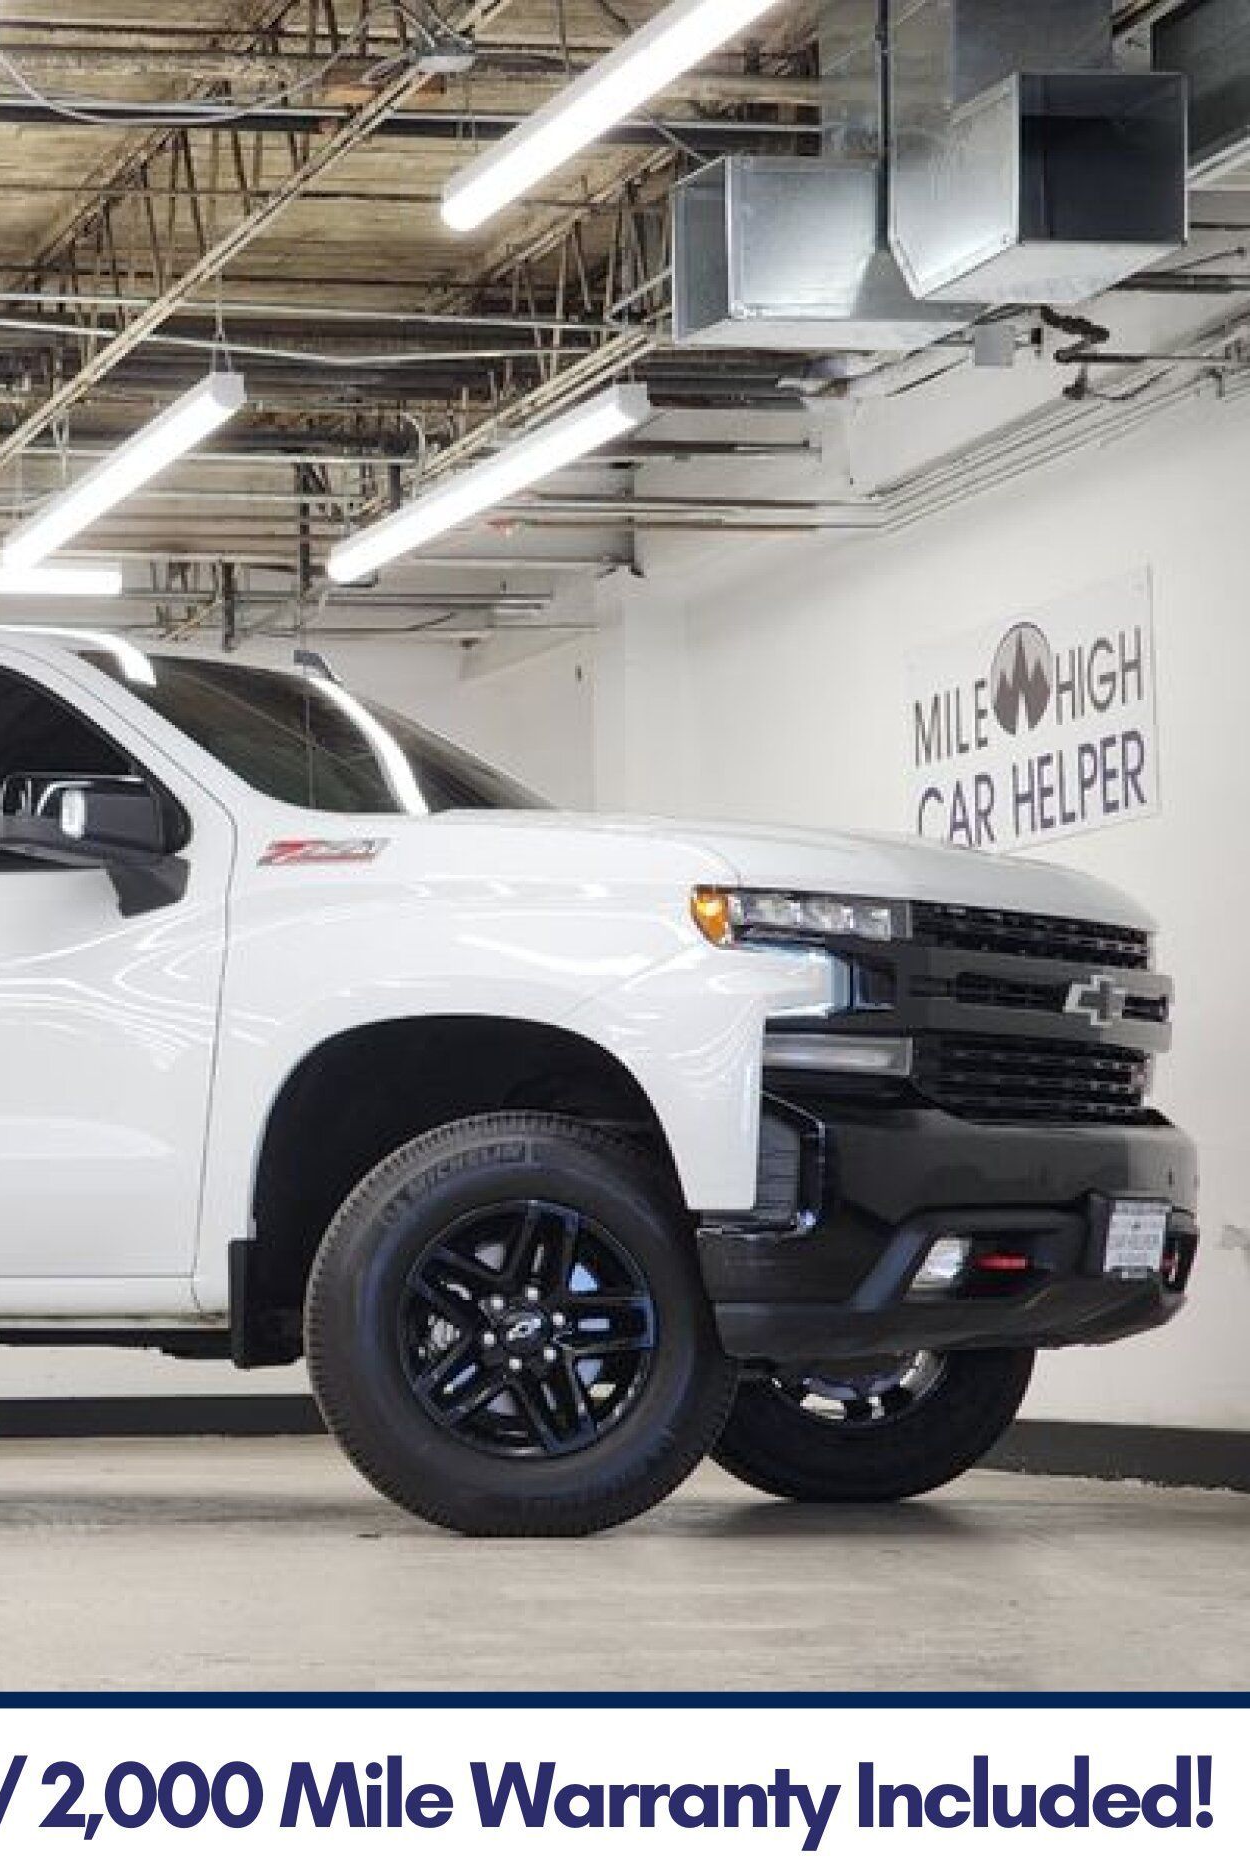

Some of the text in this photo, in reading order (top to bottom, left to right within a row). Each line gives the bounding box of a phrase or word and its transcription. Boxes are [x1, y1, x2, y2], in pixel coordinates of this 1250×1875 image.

[914, 624, 1144, 768] MILE HIGH
[917, 729, 1148, 848] CAR HELPER
